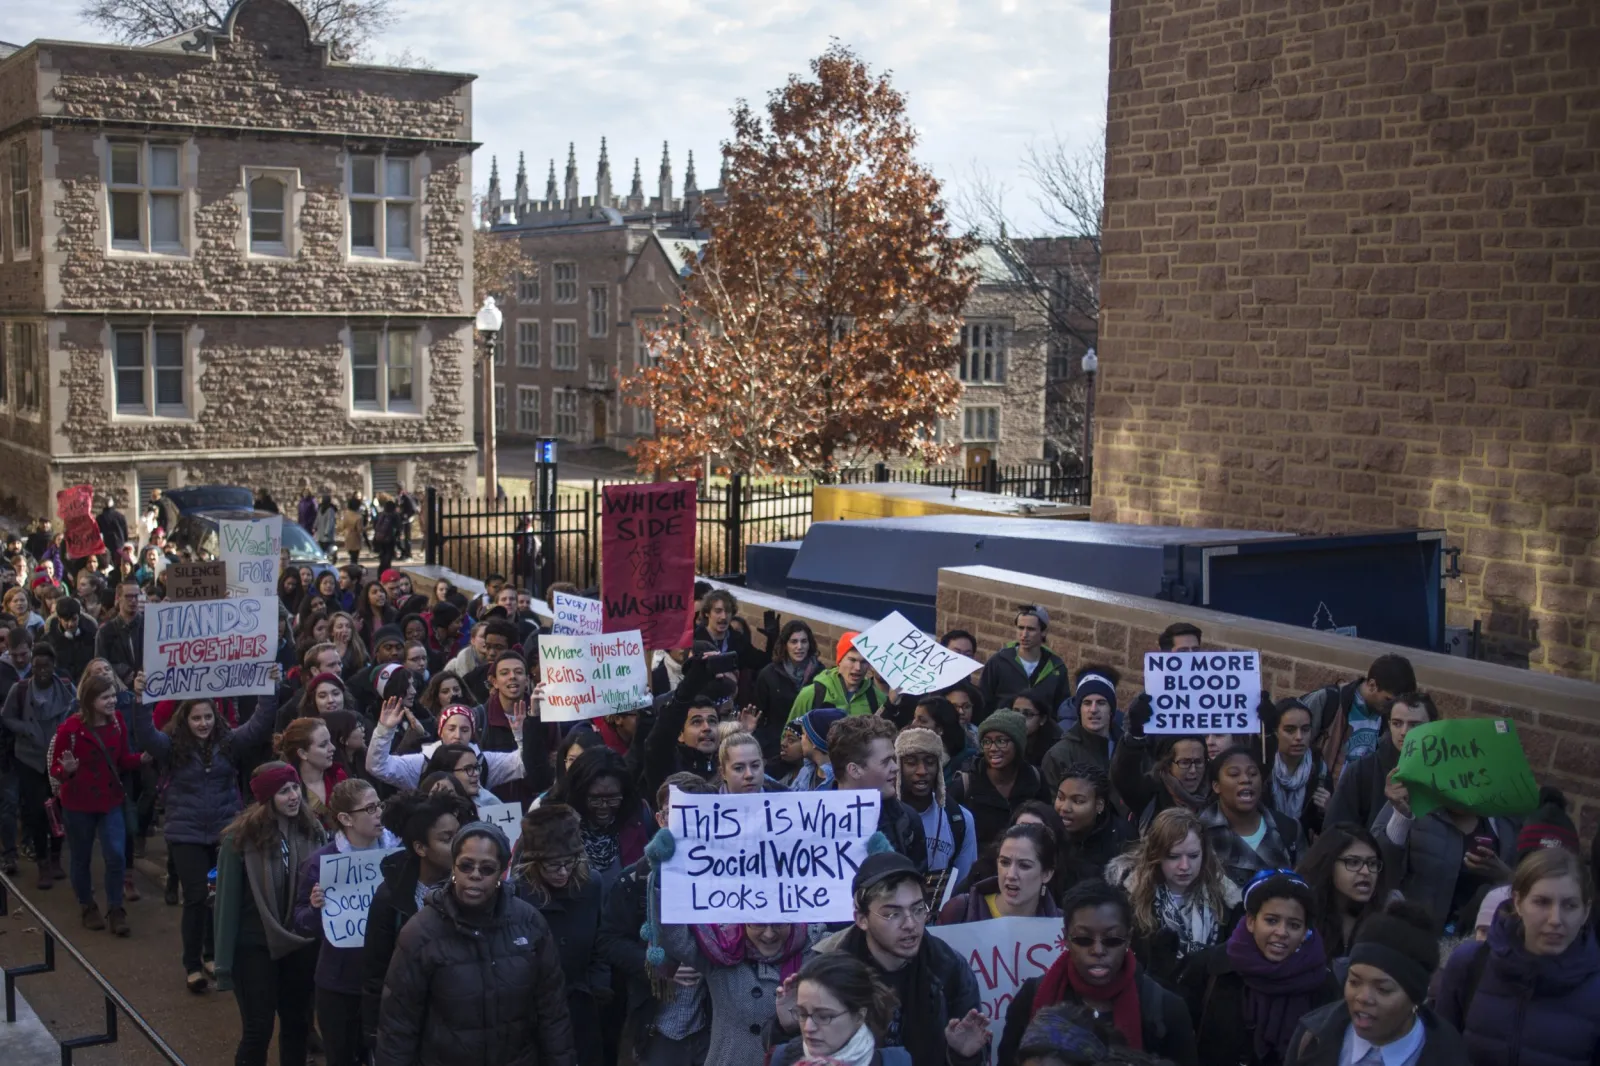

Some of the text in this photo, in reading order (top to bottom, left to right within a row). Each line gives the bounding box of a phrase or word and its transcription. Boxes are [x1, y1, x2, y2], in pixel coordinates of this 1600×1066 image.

[603, 489, 686, 514] WHICH
[617, 515, 683, 541] SIDE
[628, 543, 661, 558] ARE
[174, 565, 220, 578] SILENCE
[239, 559, 273, 583] FOR
[629, 558, 665, 577] YOU
[175, 584, 219, 598] DEATH
[636, 577, 656, 590] ON
[157, 599, 261, 641] HANDS
[159, 634, 268, 667] TOGETHER
[541, 637, 640, 664] Where injustice
[898, 629, 958, 675] BLACK
[207, 660, 276, 692] SHOOT
[592, 663, 611, 680] all
[615, 665, 631, 677] are
[856, 635, 937, 694] MATTER
[885, 642, 937, 685] LIVES
[1149, 656, 1254, 672] NO MORE
[1164, 675, 1240, 690] BLOOD
[1156, 694, 1247, 709] ON OUR
[1155, 713, 1248, 728] STREETS
[671, 795, 874, 841] This is What
[326, 856, 377, 884] This
[687, 839, 860, 880] Social WORK
[692, 882, 830, 913] Looks Like
